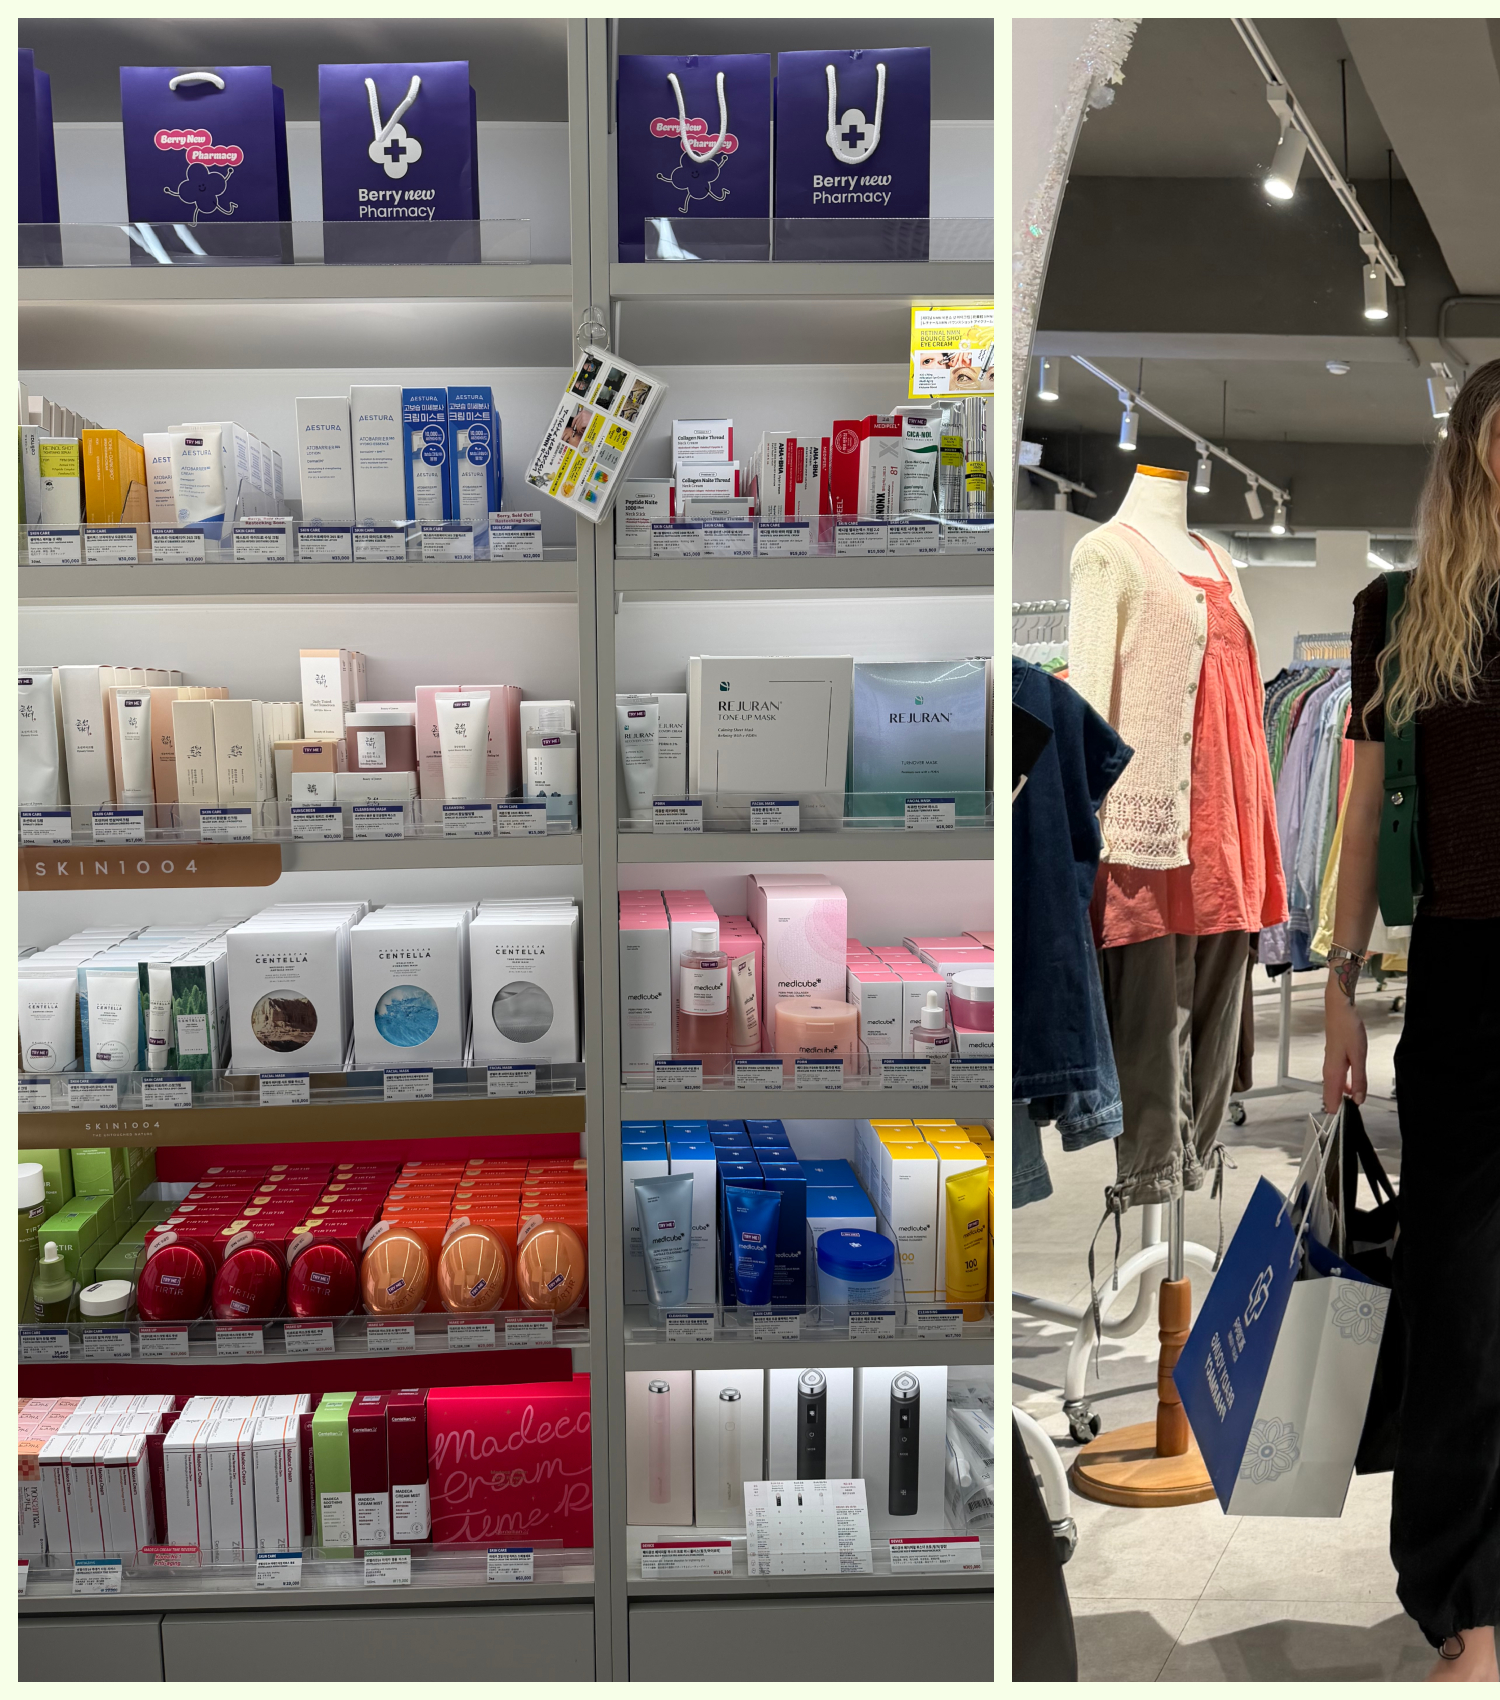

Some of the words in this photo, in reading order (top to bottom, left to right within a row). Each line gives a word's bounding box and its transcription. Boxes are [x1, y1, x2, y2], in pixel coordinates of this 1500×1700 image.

[160, 134, 186, 146] Berry
[186, 134, 206, 145] New
[192, 150, 238, 162] Pharmacy
[813, 174, 857, 191] Berry
[860, 173, 892, 186] new
[358, 188, 402, 205] Berry
[403, 189, 436, 201] new
[813, 190, 891, 206] Pharmacy
[359, 205, 436, 221] Pharmacy
[404, 404, 421, 412] 고보습
[358, 414, 394, 422] AESTURA
[305, 424, 341, 432] AESTURA
[906, 430, 932, 438] CICA-NOL
[718, 700, 781, 712] REJURAN
[889, 712, 951, 724] REJURAN
[35, 859, 198, 876] SKIN1004
[255, 955, 308, 964] CENTELLA
[378, 952, 431, 960] CENTELLA
[778, 979, 818, 988] medicube
[85, 1121, 160, 1131] SKIN1004
[154, 1285, 184, 1296] TIRTIR
